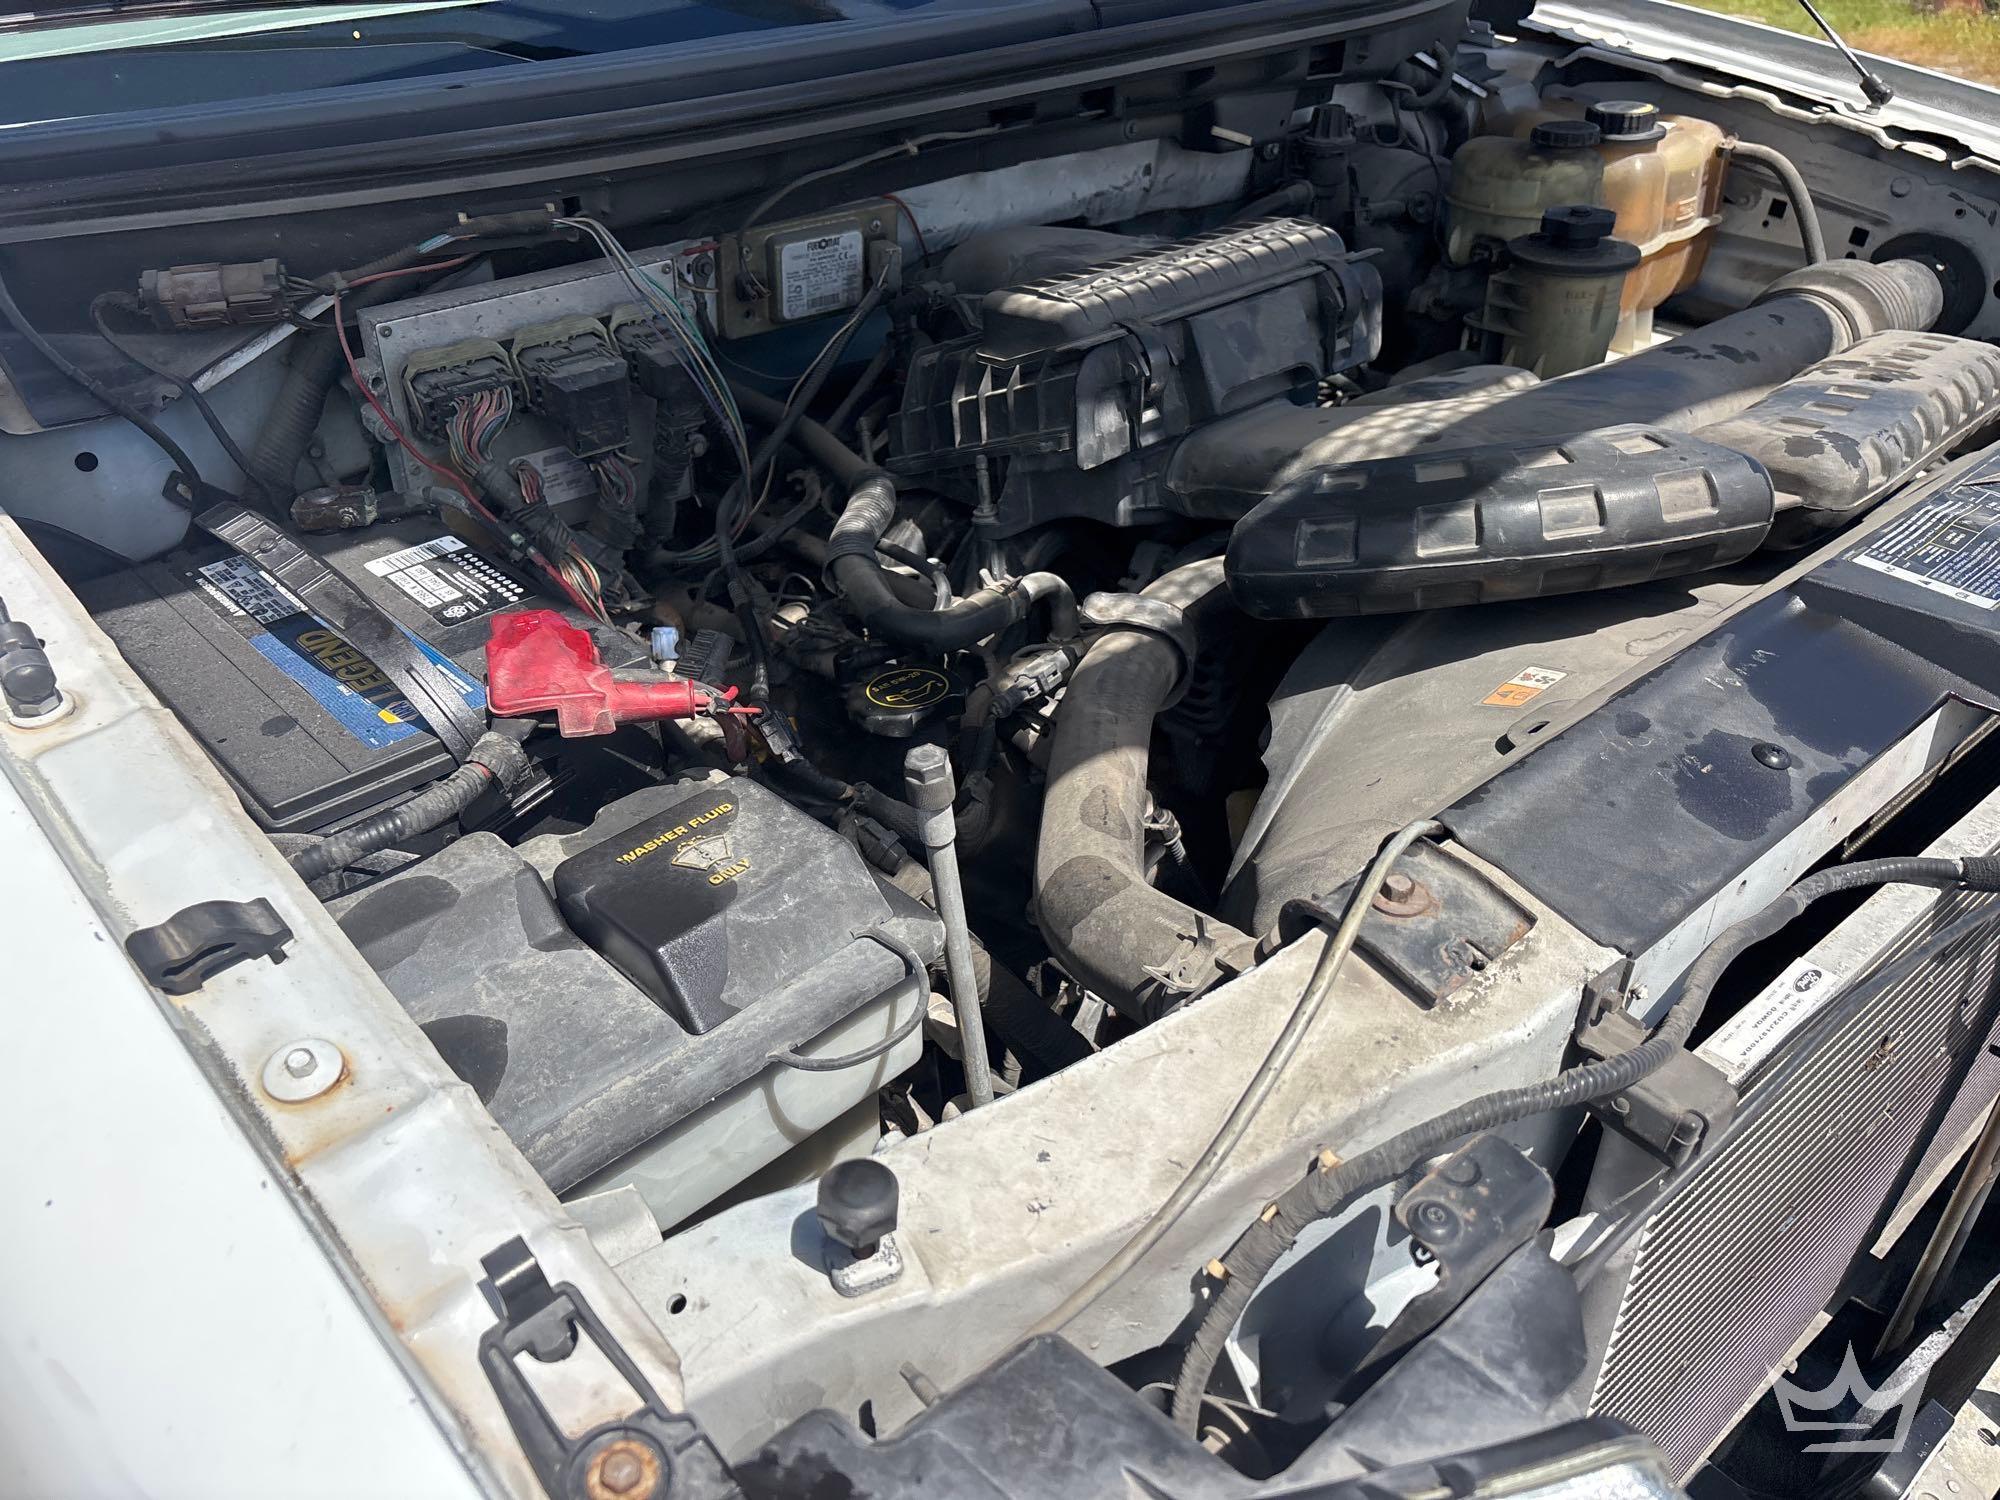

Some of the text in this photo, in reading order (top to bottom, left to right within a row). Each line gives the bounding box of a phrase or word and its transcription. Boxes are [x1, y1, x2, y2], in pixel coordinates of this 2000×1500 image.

[297, 629, 401, 701] LEGEND
[615, 802, 734, 866] WASHER FLUID
[707, 857, 751, 886] ONLY
[1795, 969, 1822, 991] Ford
